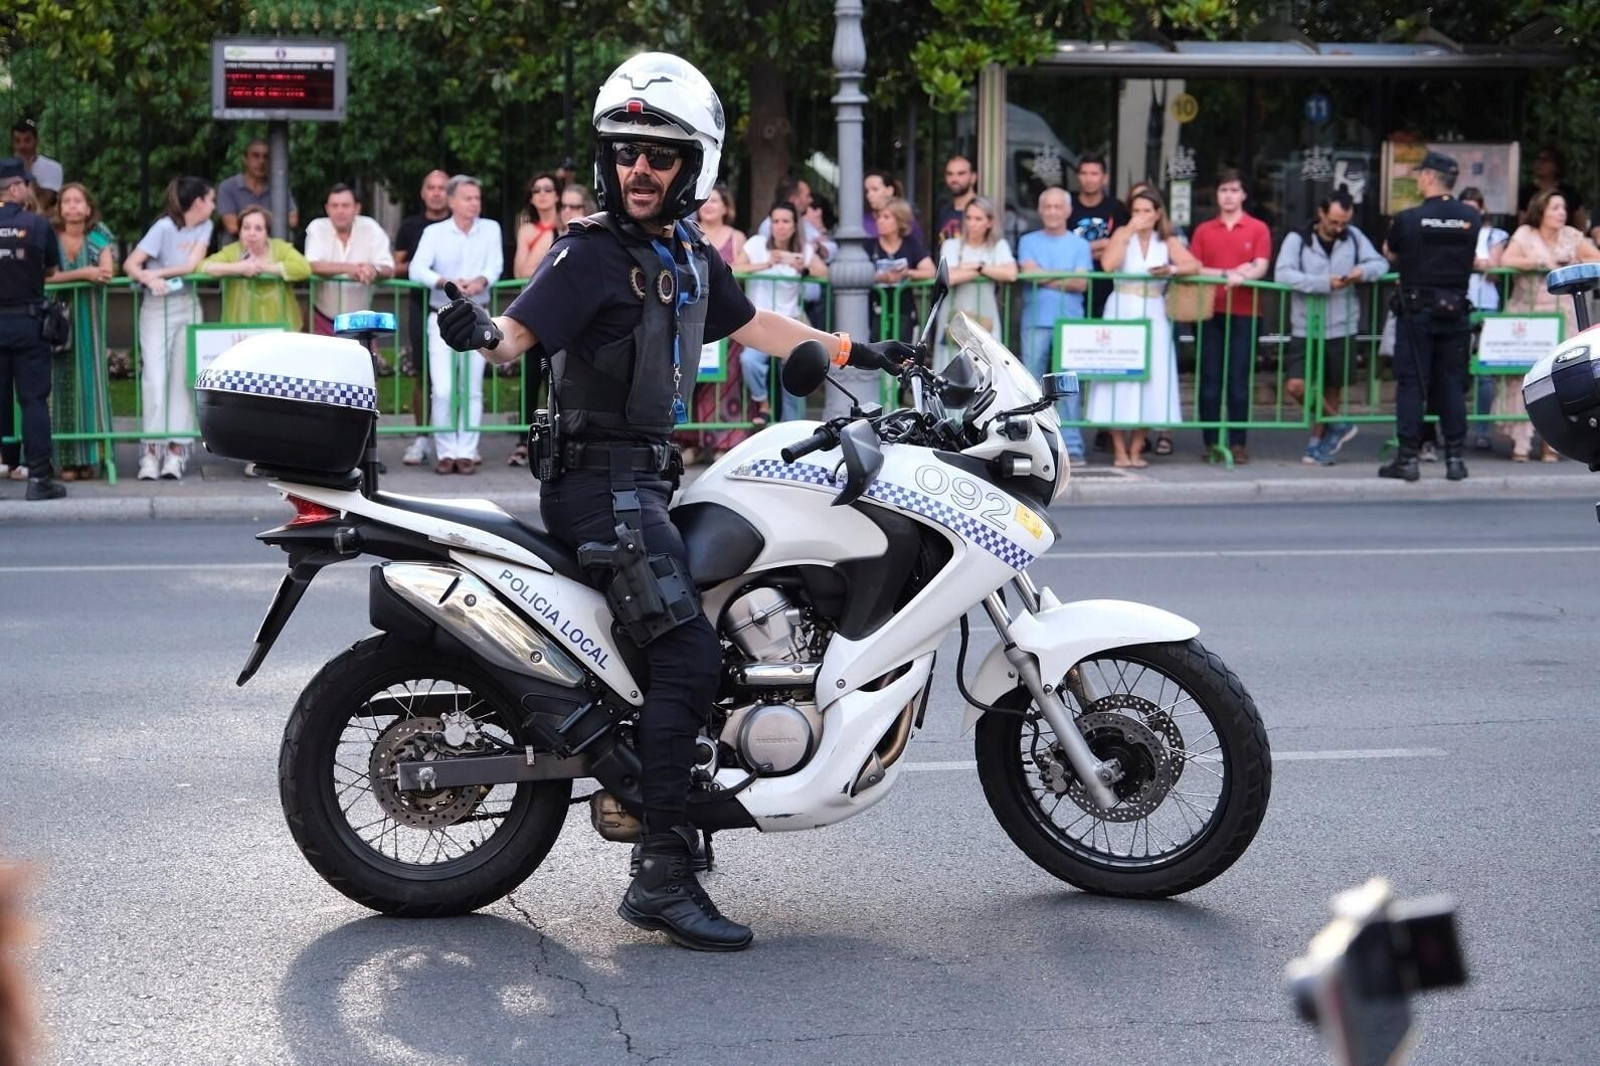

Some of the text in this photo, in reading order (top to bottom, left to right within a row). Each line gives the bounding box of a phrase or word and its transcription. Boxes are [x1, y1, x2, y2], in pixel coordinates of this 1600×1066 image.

[1174, 101, 1194, 117] 10
[1308, 100, 1328, 117] 11
[915, 464, 1011, 530] 092
[498, 569, 610, 670] POLICIA LOCAL
